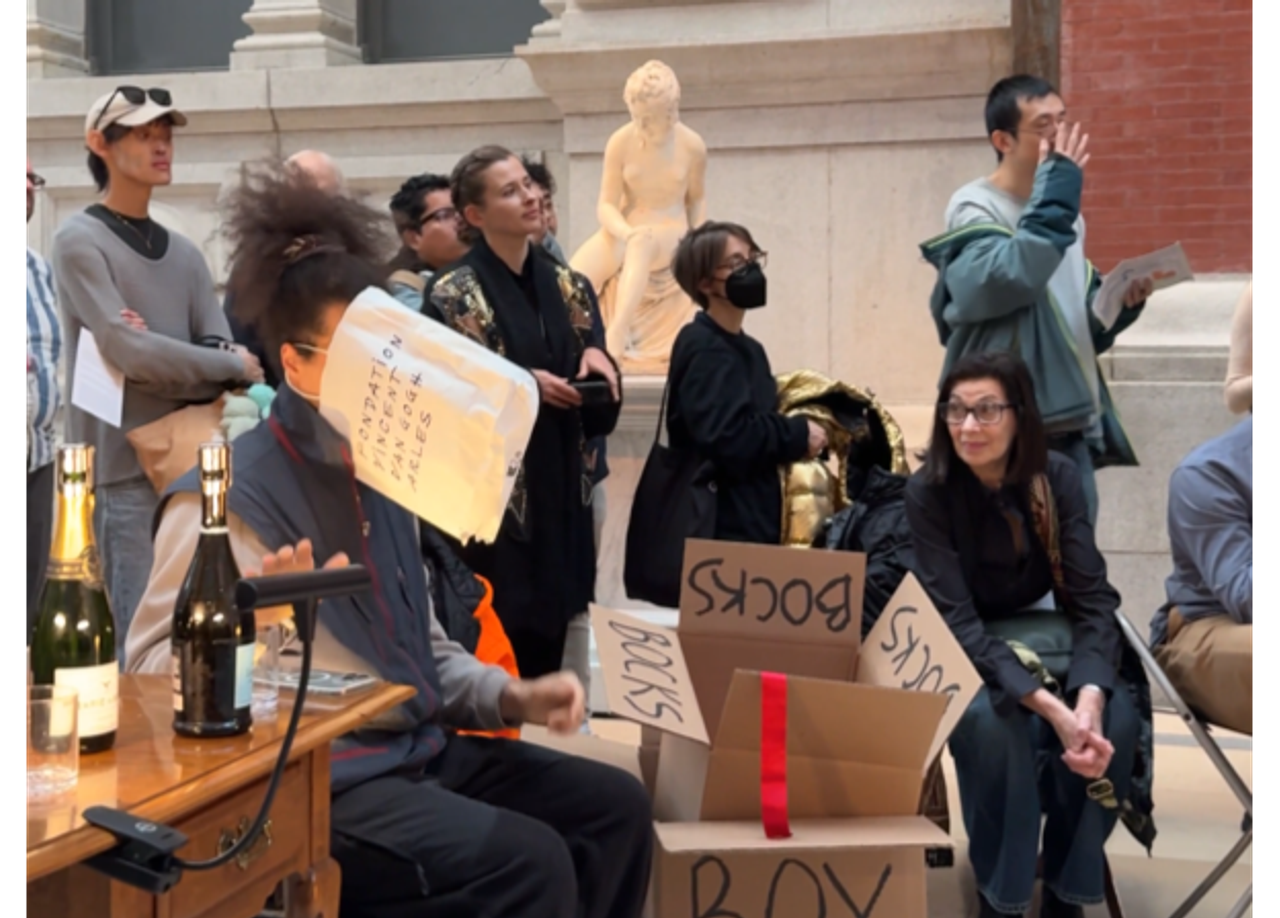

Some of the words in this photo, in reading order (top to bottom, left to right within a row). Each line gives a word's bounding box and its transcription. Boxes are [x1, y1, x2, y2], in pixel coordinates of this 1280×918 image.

[390, 436, 407, 481] VAN
[399, 372, 423, 431] GOGH
[406, 410, 432, 493] ARLES
[688, 557, 852, 633] BOCKS
[607, 619, 684, 724] BOCKS
